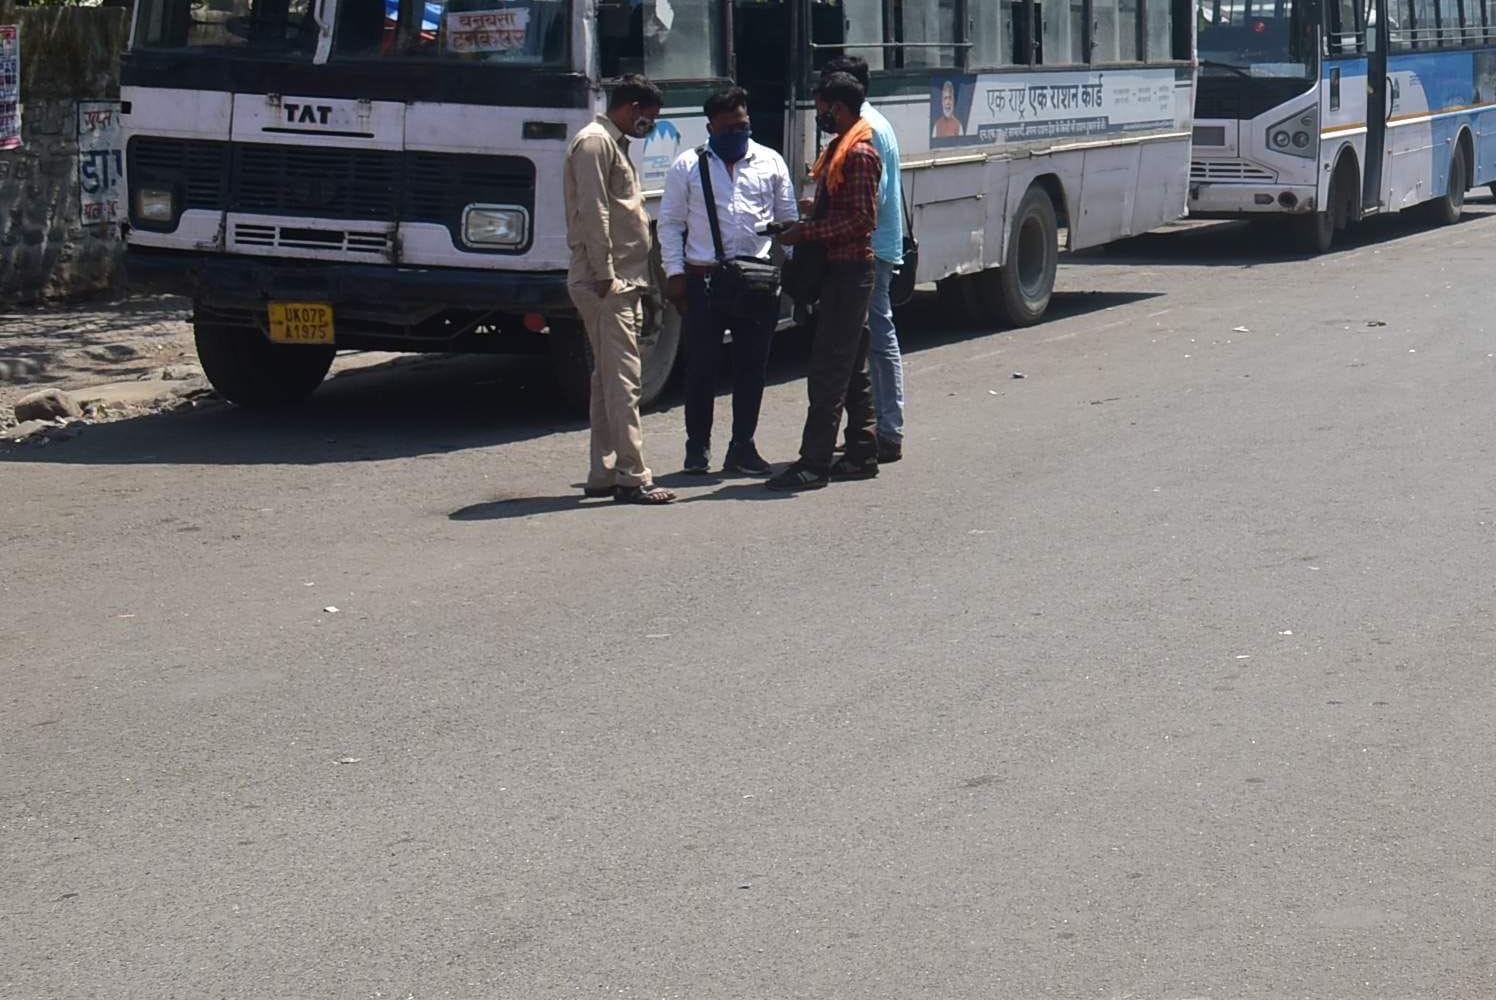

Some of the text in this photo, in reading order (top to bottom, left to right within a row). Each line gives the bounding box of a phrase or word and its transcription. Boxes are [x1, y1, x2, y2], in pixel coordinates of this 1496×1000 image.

[987, 89, 1005, 118] एक
[1028, 86, 1048, 117] एक
[1049, 84, 1079, 110] राशन
[1081, 73, 1104, 109] कार्ड
[284, 103, 332, 124] TAT
